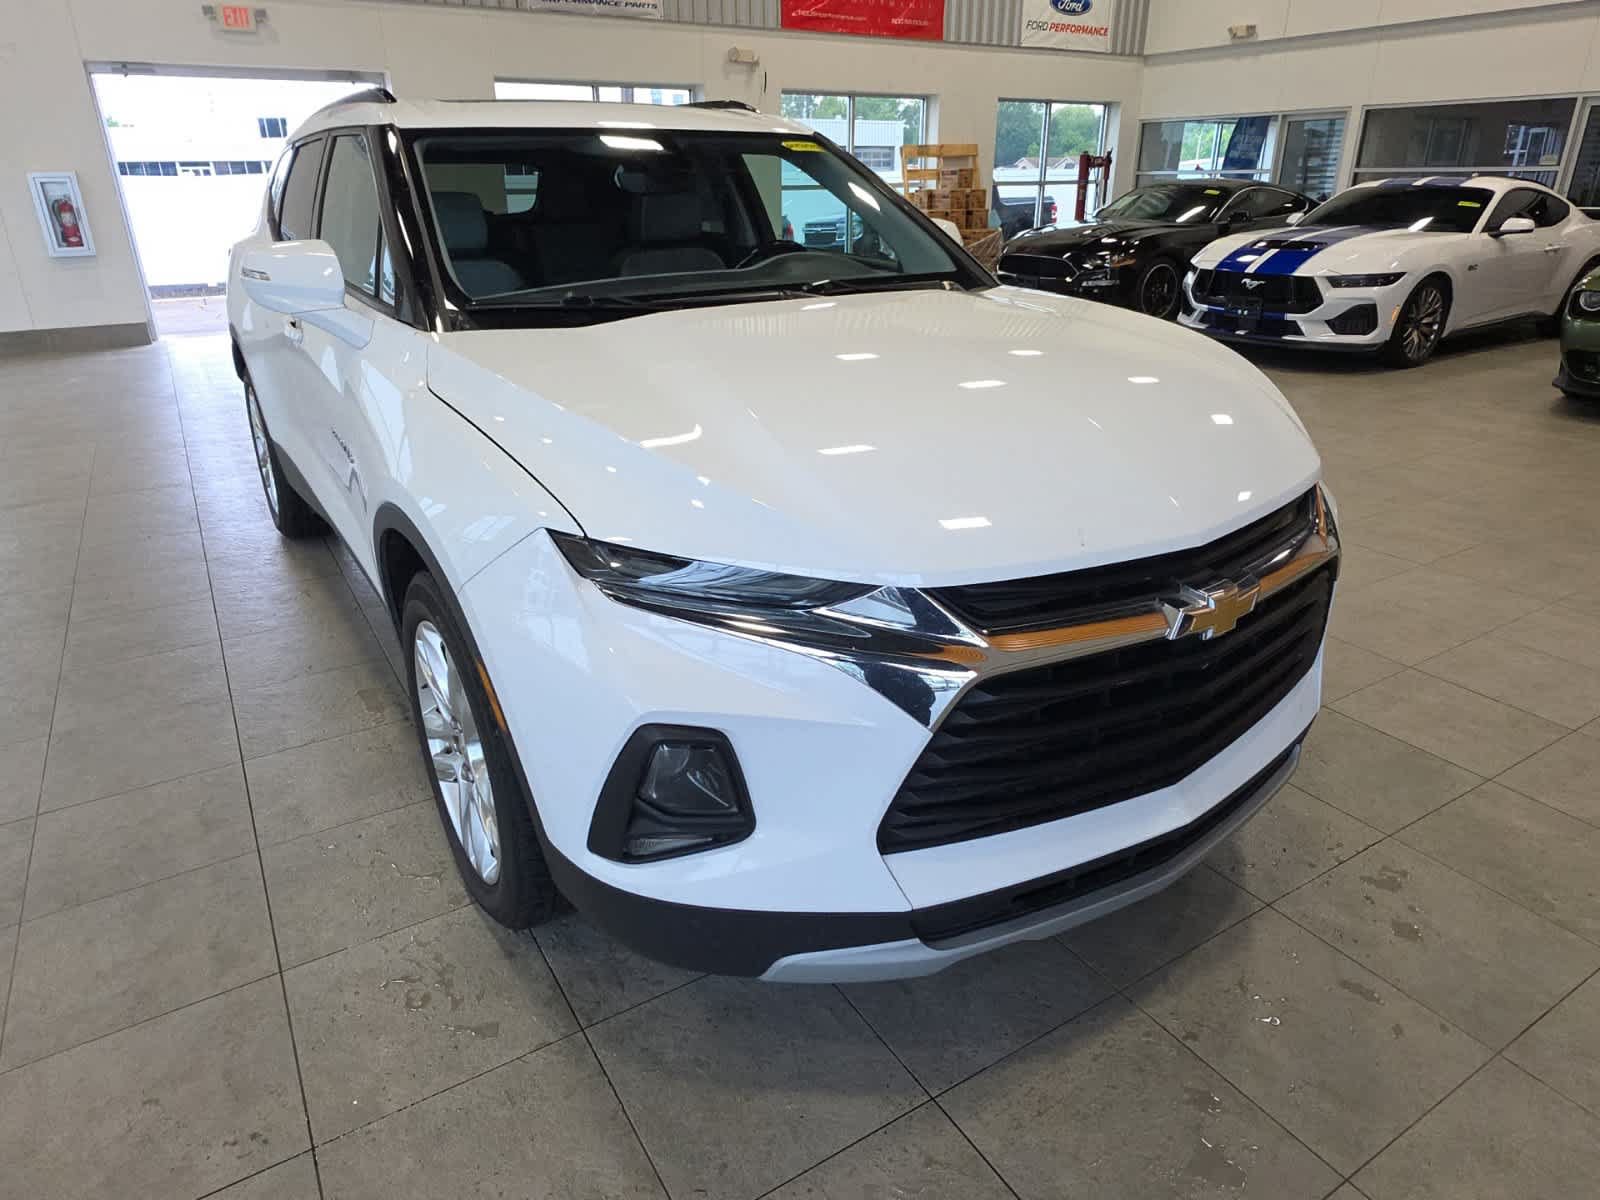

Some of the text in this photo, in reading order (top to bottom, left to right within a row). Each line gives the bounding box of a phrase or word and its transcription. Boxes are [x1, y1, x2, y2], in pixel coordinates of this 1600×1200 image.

[624, 1, 658, 9] PARTS
[1058, 0, 1083, 12] Ford
[224, 7, 249, 27] EXIT
[1026, 20, 1109, 37] FORD PERFORMANCE
